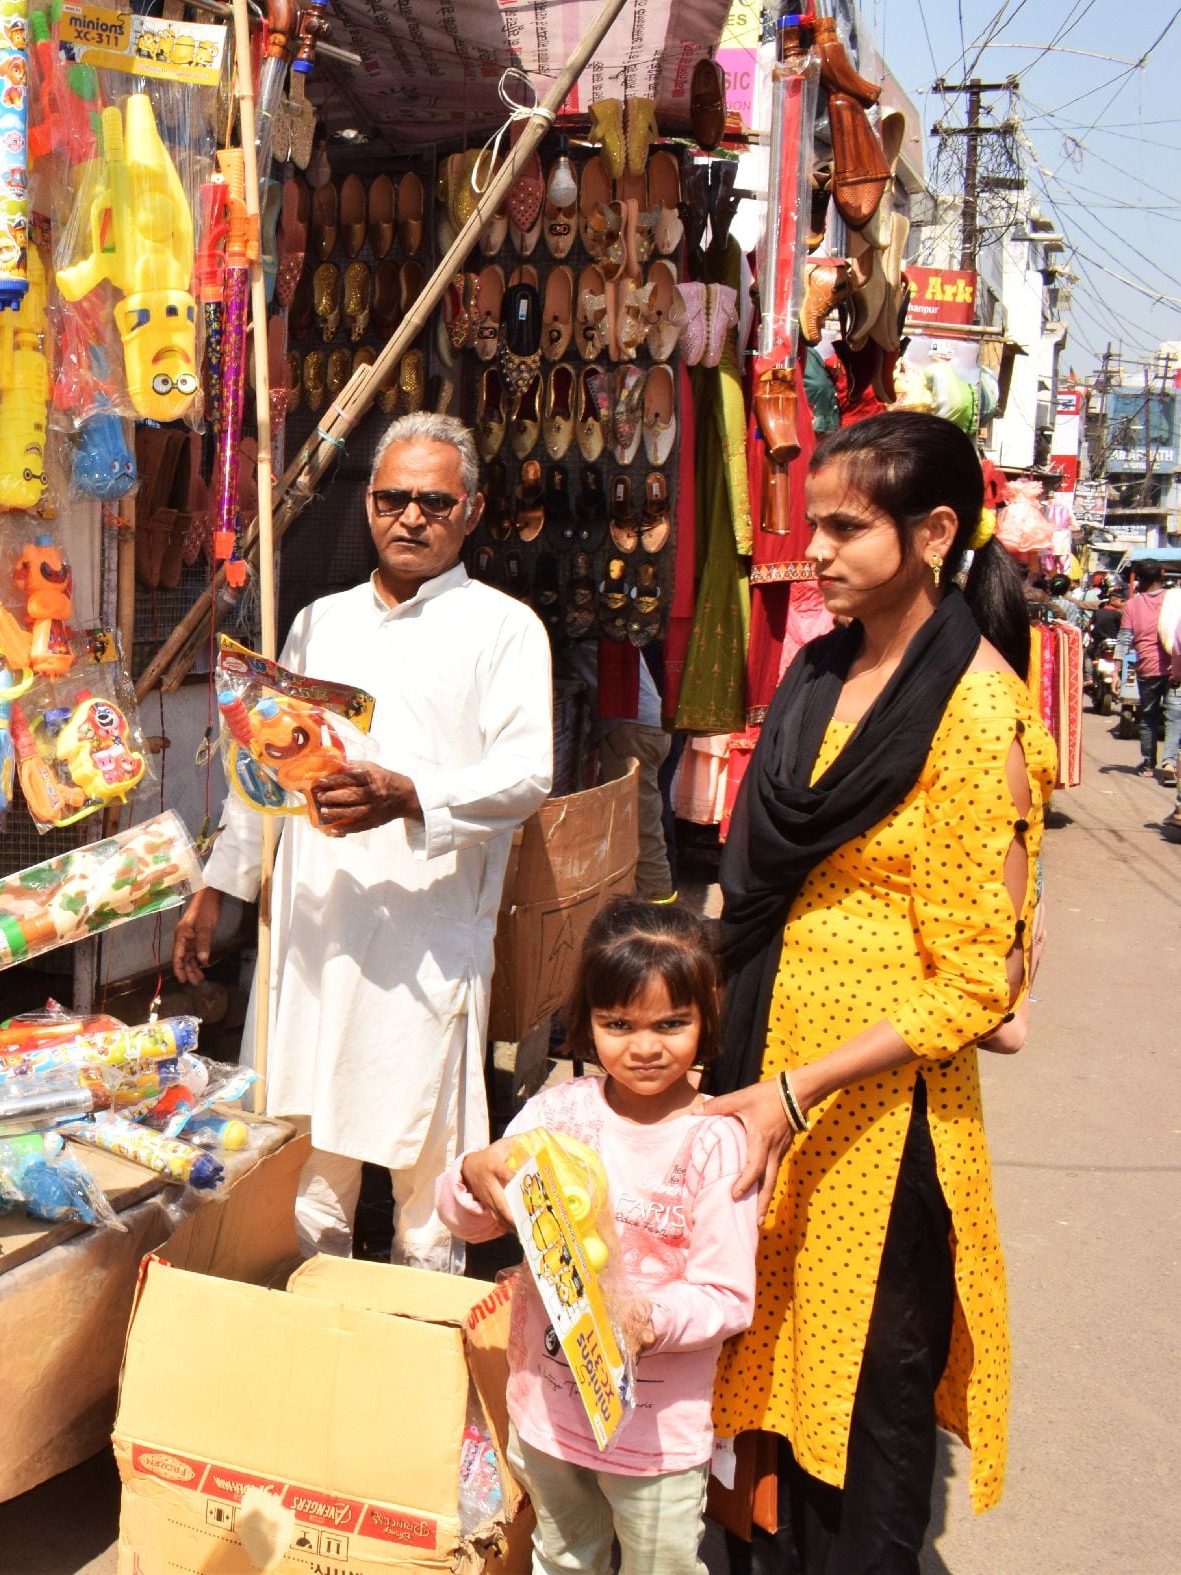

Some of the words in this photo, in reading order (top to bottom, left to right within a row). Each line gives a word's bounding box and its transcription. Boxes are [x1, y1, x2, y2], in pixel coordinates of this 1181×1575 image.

[69, 15, 125, 36] minions
[74, 29, 119, 47] XC-311
[724, 71, 751, 91] SIC
[925, 276, 973, 304] Ark
[908, 302, 939, 315] hanpur
[617, 1191, 685, 1229] PARIS
[576, 1332, 611, 1422] minions
[586, 1329, 615, 1403] XC-311
[145, 1458, 188, 1477] FROZEN
[291, 1496, 353, 1526] AVENGERS
